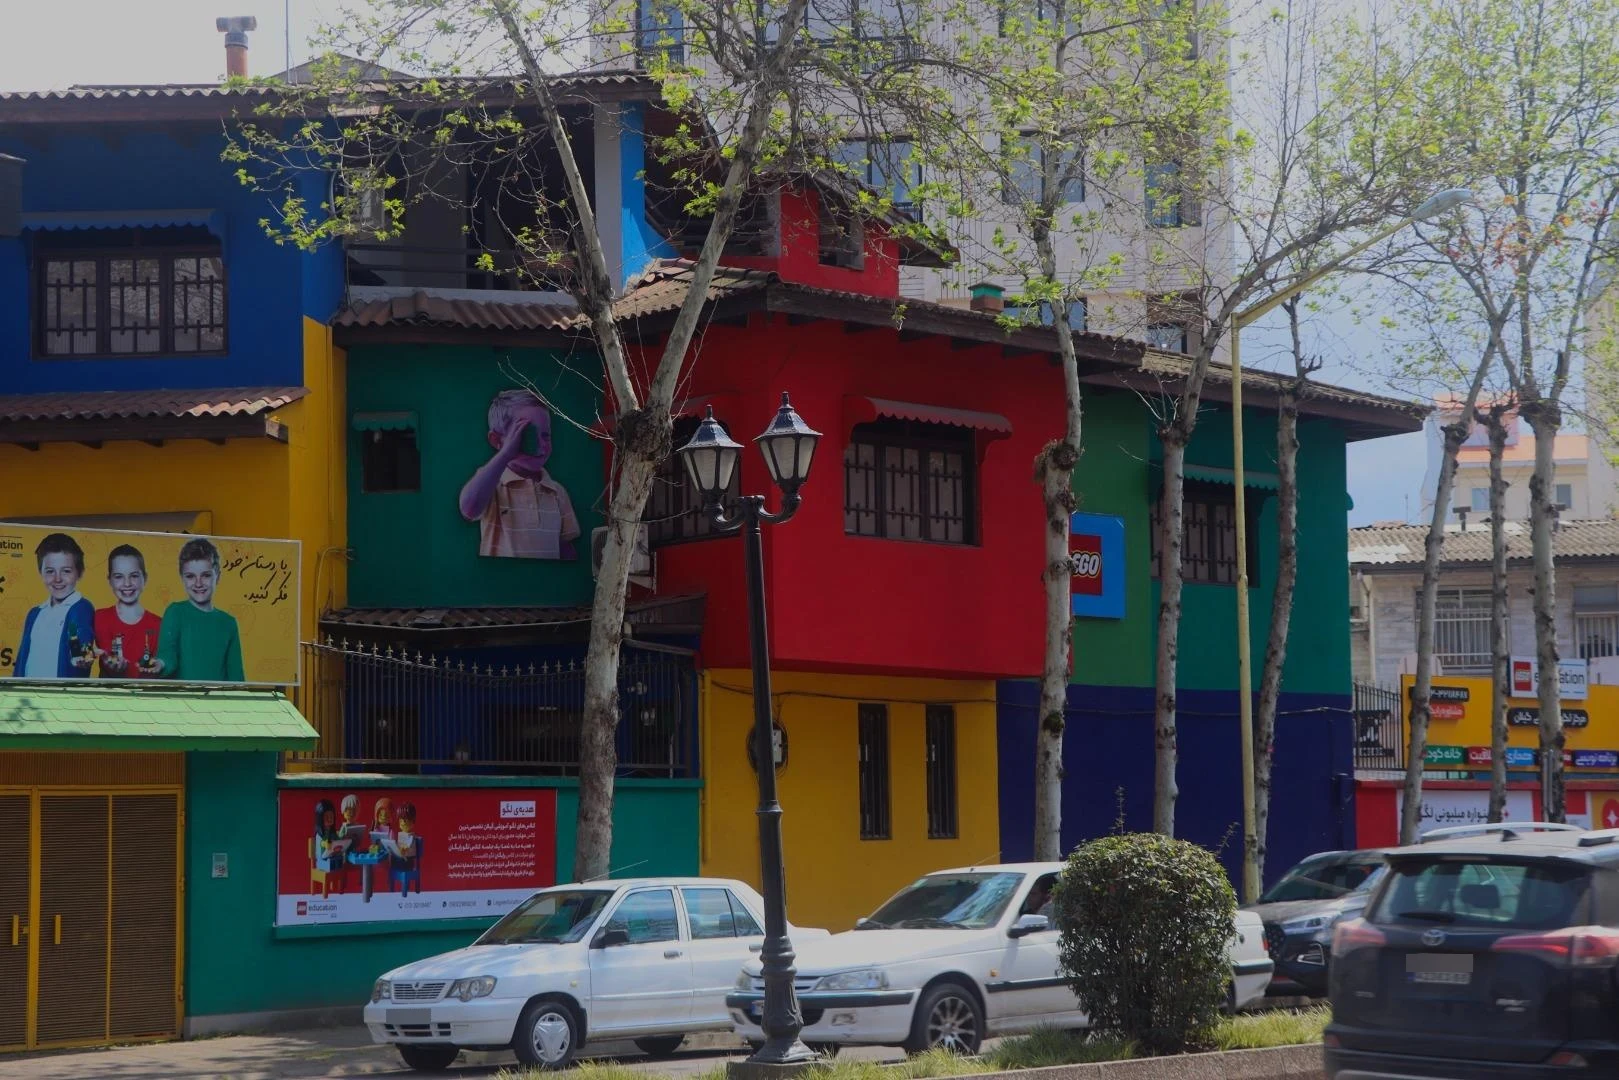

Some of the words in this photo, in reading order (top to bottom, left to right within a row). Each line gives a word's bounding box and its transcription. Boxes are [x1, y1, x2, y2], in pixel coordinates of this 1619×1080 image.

[223, 549, 243, 571] خود
[240, 555, 276, 579] دستان
[281, 559, 287, 575] با
[1071, 552, 1101, 576] EGO
[271, 571, 292, 605] فکر
[1534, 669, 1585, 685] eation
[1427, 748, 1443, 763] کود
[502, 803, 513, 816] لگو
